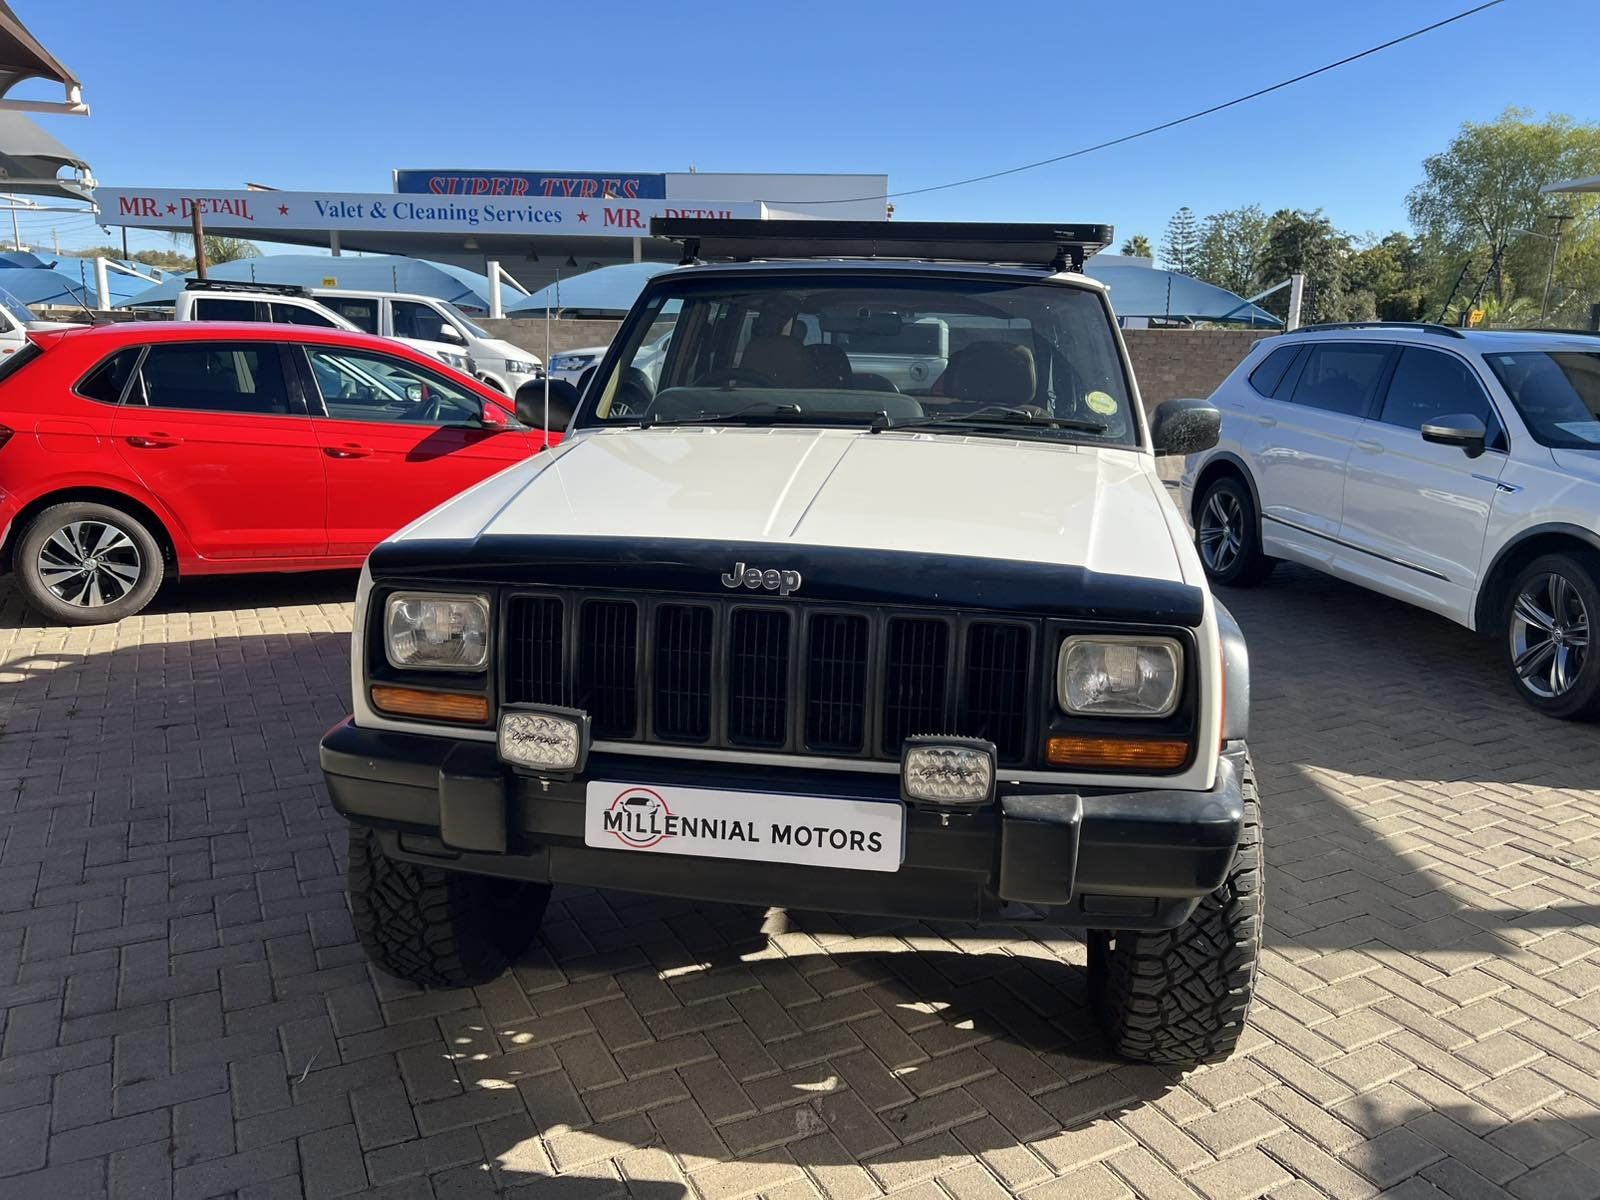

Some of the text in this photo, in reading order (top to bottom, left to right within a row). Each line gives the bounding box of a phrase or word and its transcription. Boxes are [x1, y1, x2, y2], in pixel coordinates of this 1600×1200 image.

[428, 176, 640, 199] SUPER TYRES
[118, 196, 163, 217] MR.
[179, 197, 254, 221] DETAIL
[313, 200, 364, 219] Valet
[369, 201, 387, 220] &
[392, 203, 480, 226] Cleaning
[483, 204, 563, 224] Services
[602, 207, 647, 229] MR.
[721, 562, 802, 596] Jeep
[603, 809, 883, 853] MILLENNIAL MOTORS
